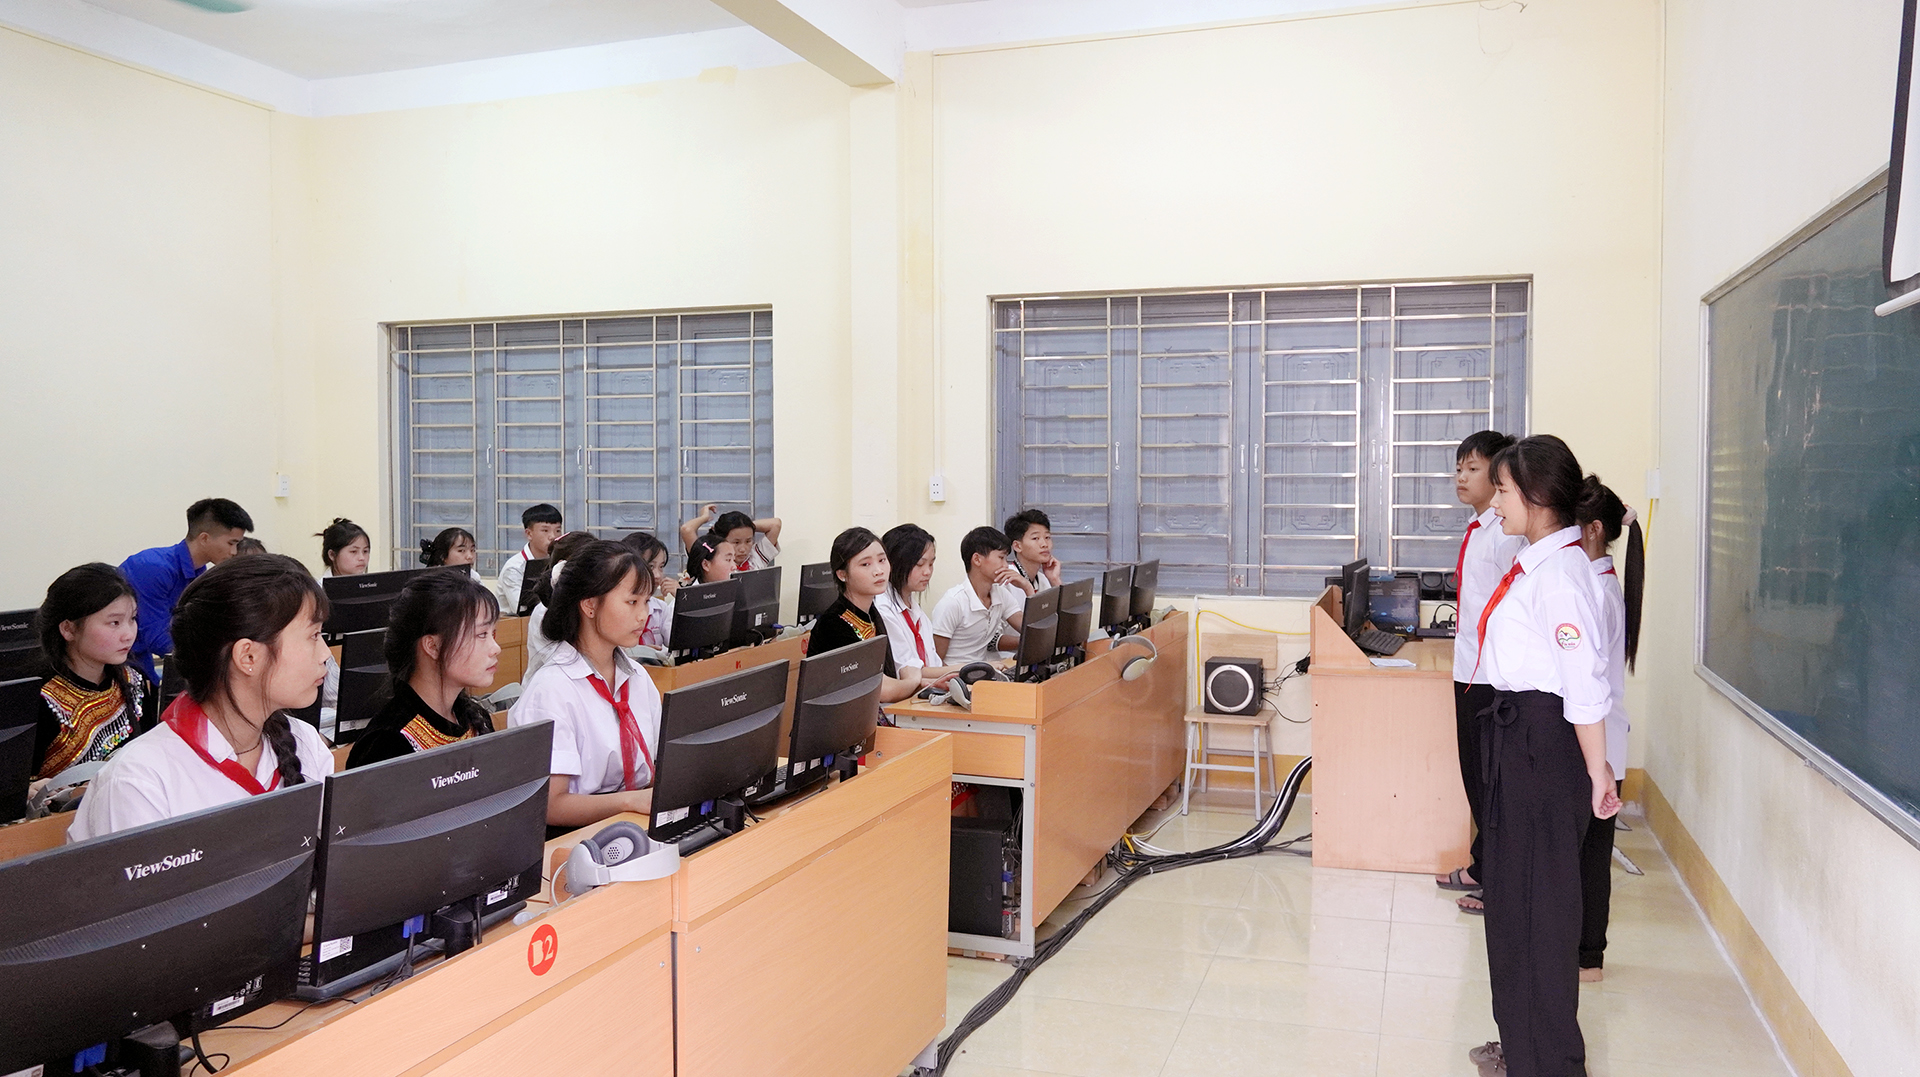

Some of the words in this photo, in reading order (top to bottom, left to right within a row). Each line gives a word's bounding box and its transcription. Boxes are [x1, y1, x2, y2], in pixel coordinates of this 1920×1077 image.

[0, 622, 29, 631] iewSonic
[840, 661, 860, 674] ViewSonic
[720, 691, 748, 707] ViewSonic
[430, 766, 480, 790] ViewSonic
[124, 848, 205, 882] ViewSonic
